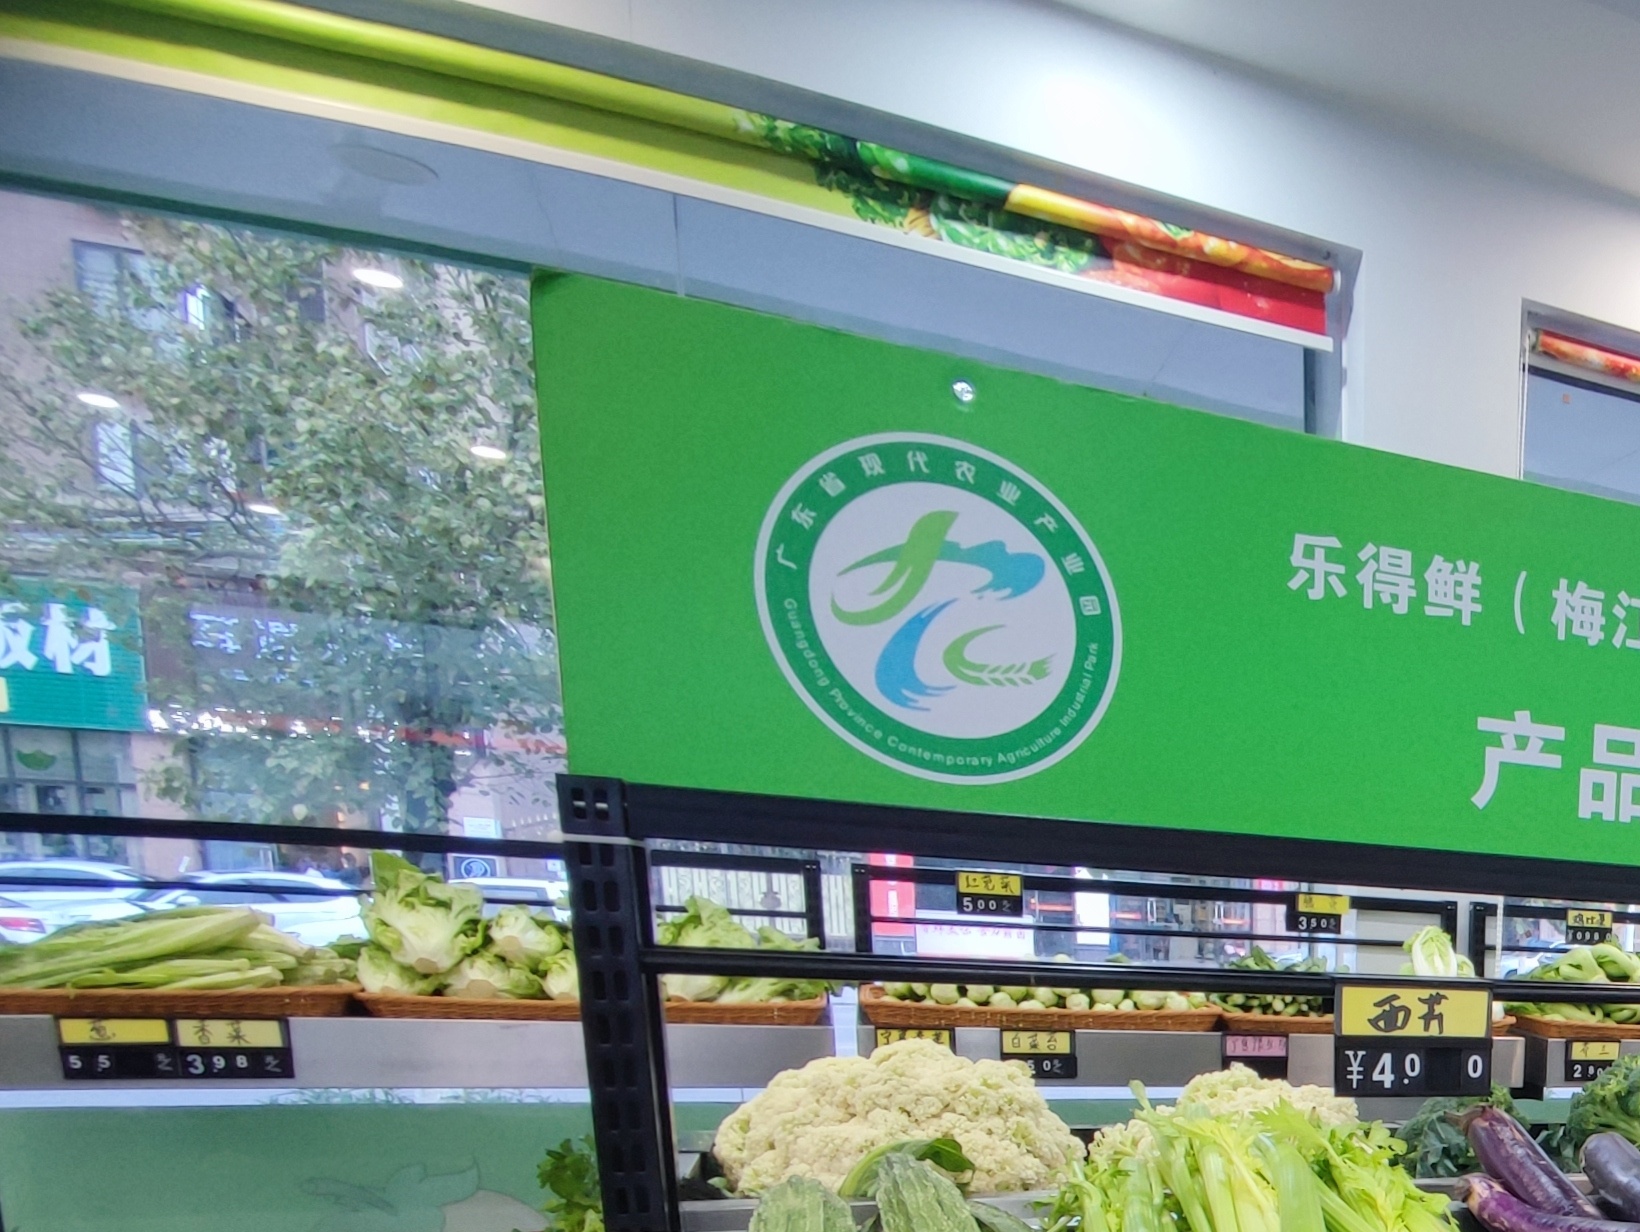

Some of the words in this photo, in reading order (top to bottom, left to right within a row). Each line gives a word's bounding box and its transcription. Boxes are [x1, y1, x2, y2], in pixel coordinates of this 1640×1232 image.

[776, 449, 1101, 616] 广东省现代农业产业园
[784, 598, 830, 687] Guangdong
[829, 687, 884, 741] Province
[887, 734, 993, 767] Contemporary
[997, 725, 1062, 766] Agriculture
[1058, 672, 1092, 728] Industrial
[1083, 641, 1099, 670] Park
